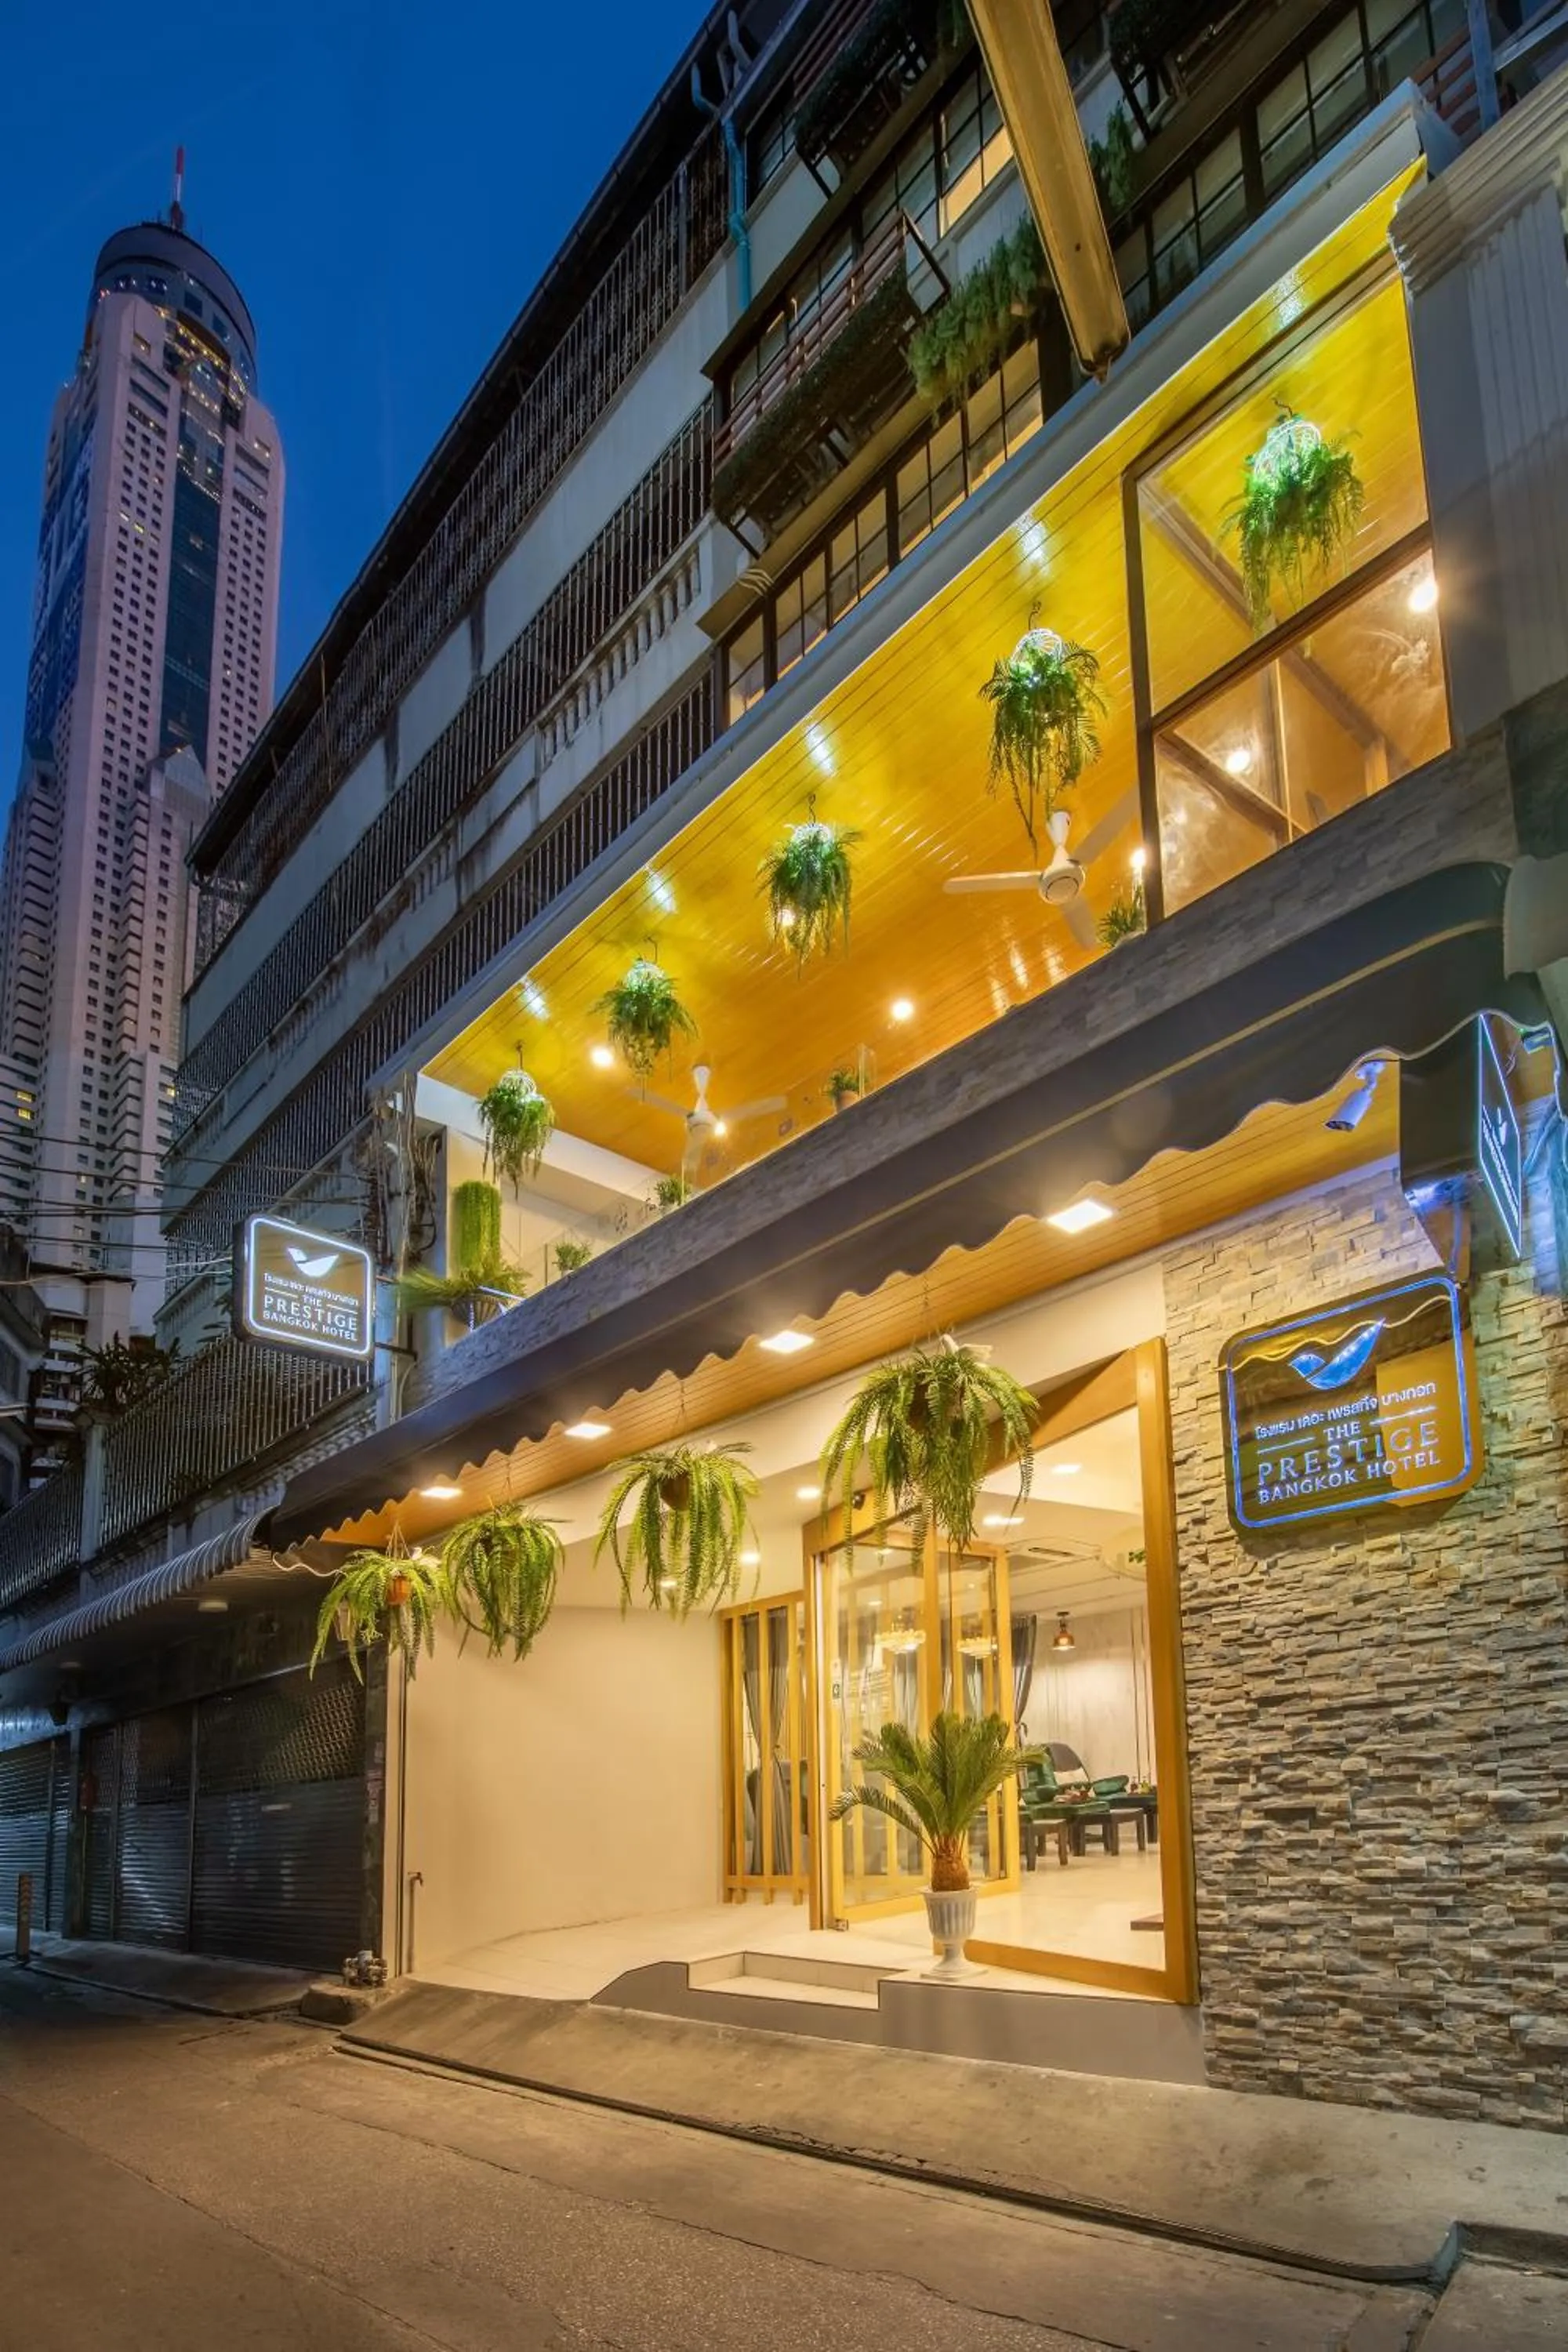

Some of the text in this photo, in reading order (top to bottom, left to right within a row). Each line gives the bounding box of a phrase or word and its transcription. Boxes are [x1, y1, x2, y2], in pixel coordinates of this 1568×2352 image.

[263, 1295, 358, 1331] PRESTIGE
[302, 1294, 322, 1307] THE
[263, 1311, 358, 1342] BANGKOK HOTEL
[1323, 1421, 1361, 1441] THE
[1258, 1421, 1439, 1486] PRESTIGE
[1259, 1450, 1441, 1504] BANGKOK HOTEL
